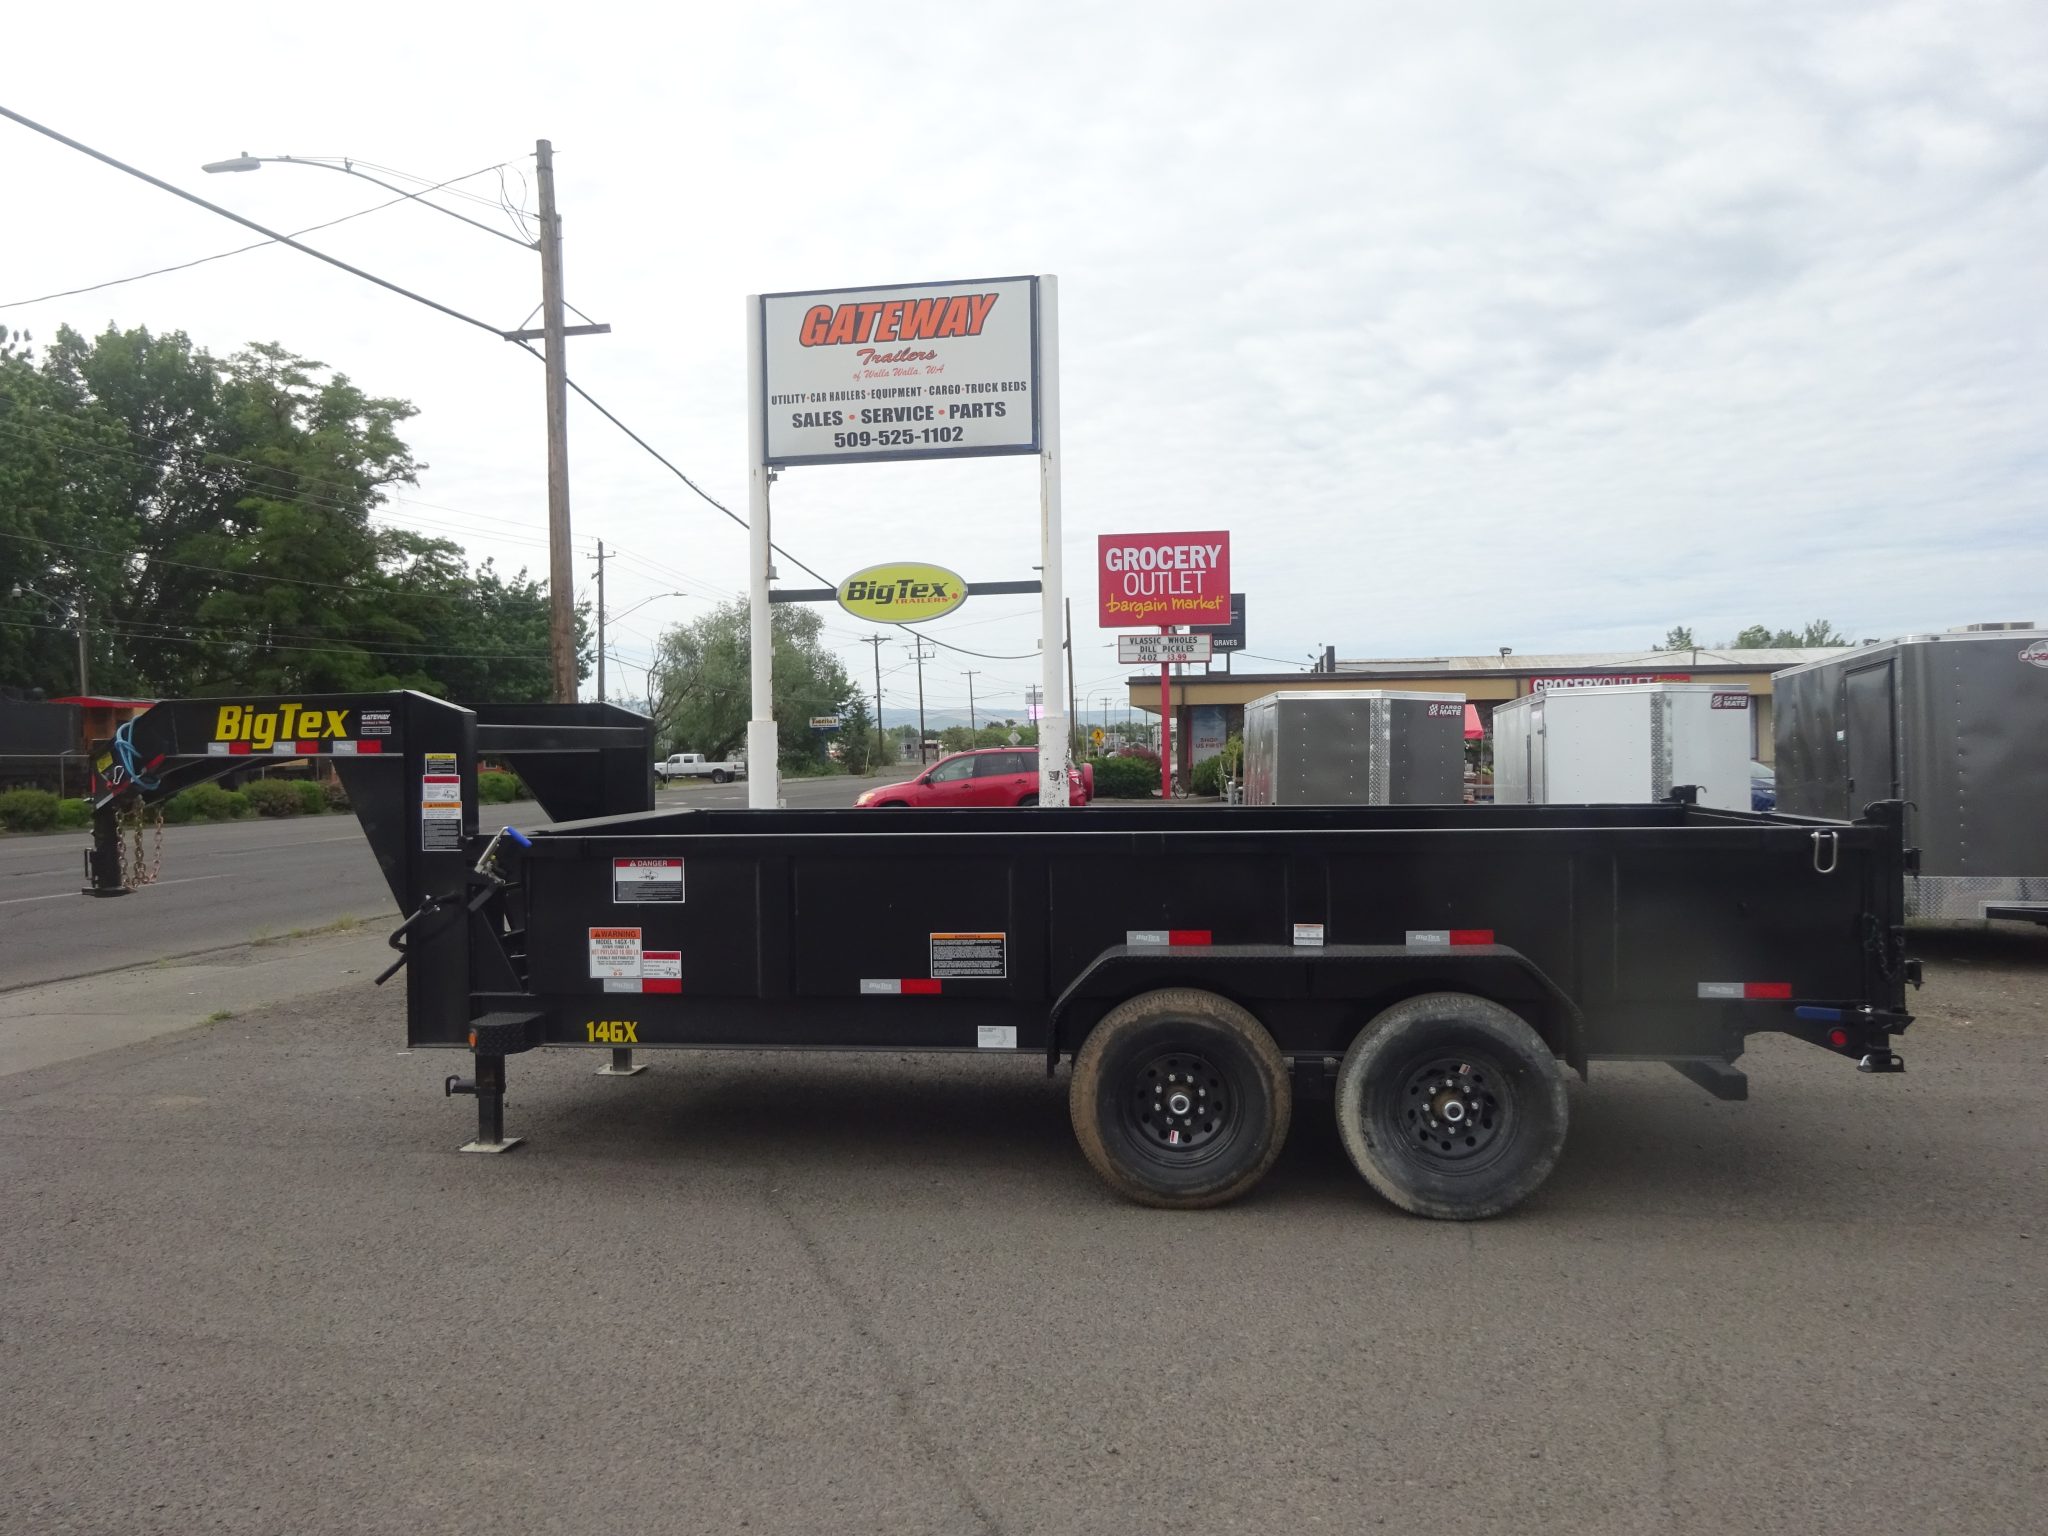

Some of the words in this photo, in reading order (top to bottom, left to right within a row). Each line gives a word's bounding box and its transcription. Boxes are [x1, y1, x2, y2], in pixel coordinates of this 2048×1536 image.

[799, 293, 999, 347] GATEWAY
[857, 347, 937, 365] Trailers
[853, 371, 861, 381] of
[864, 369, 889, 378] Walla
[926, 364, 944, 374] WA
[772, 394, 806, 405] UTILITY
[811, 393, 826, 403] CAR
[830, 390, 866, 401] HAULERS
[871, 386, 922, 399] EQUIPMENT
[929, 385, 960, 395] CARGO
[965, 383, 998, 394] TRUCK
[1001, 381, 1026, 392] BEDS
[792, 411, 843, 428] SALES
[861, 406, 934, 424] SERVICE
[950, 402, 1006, 419] PARTS
[834, 426, 963, 448] 509-525-1102
[1106, 545, 1222, 571] GROCERY
[847, 579, 948, 604] BigTex
[1123, 571, 1206, 595] OUTLET
[1106, 593, 1167, 619] bargain
[1171, 595, 1223, 610] market
[1167, 636, 1198, 644] WHOLES
[215, 703, 349, 749] BigTex
[586, 1021, 638, 1042] 14GX
